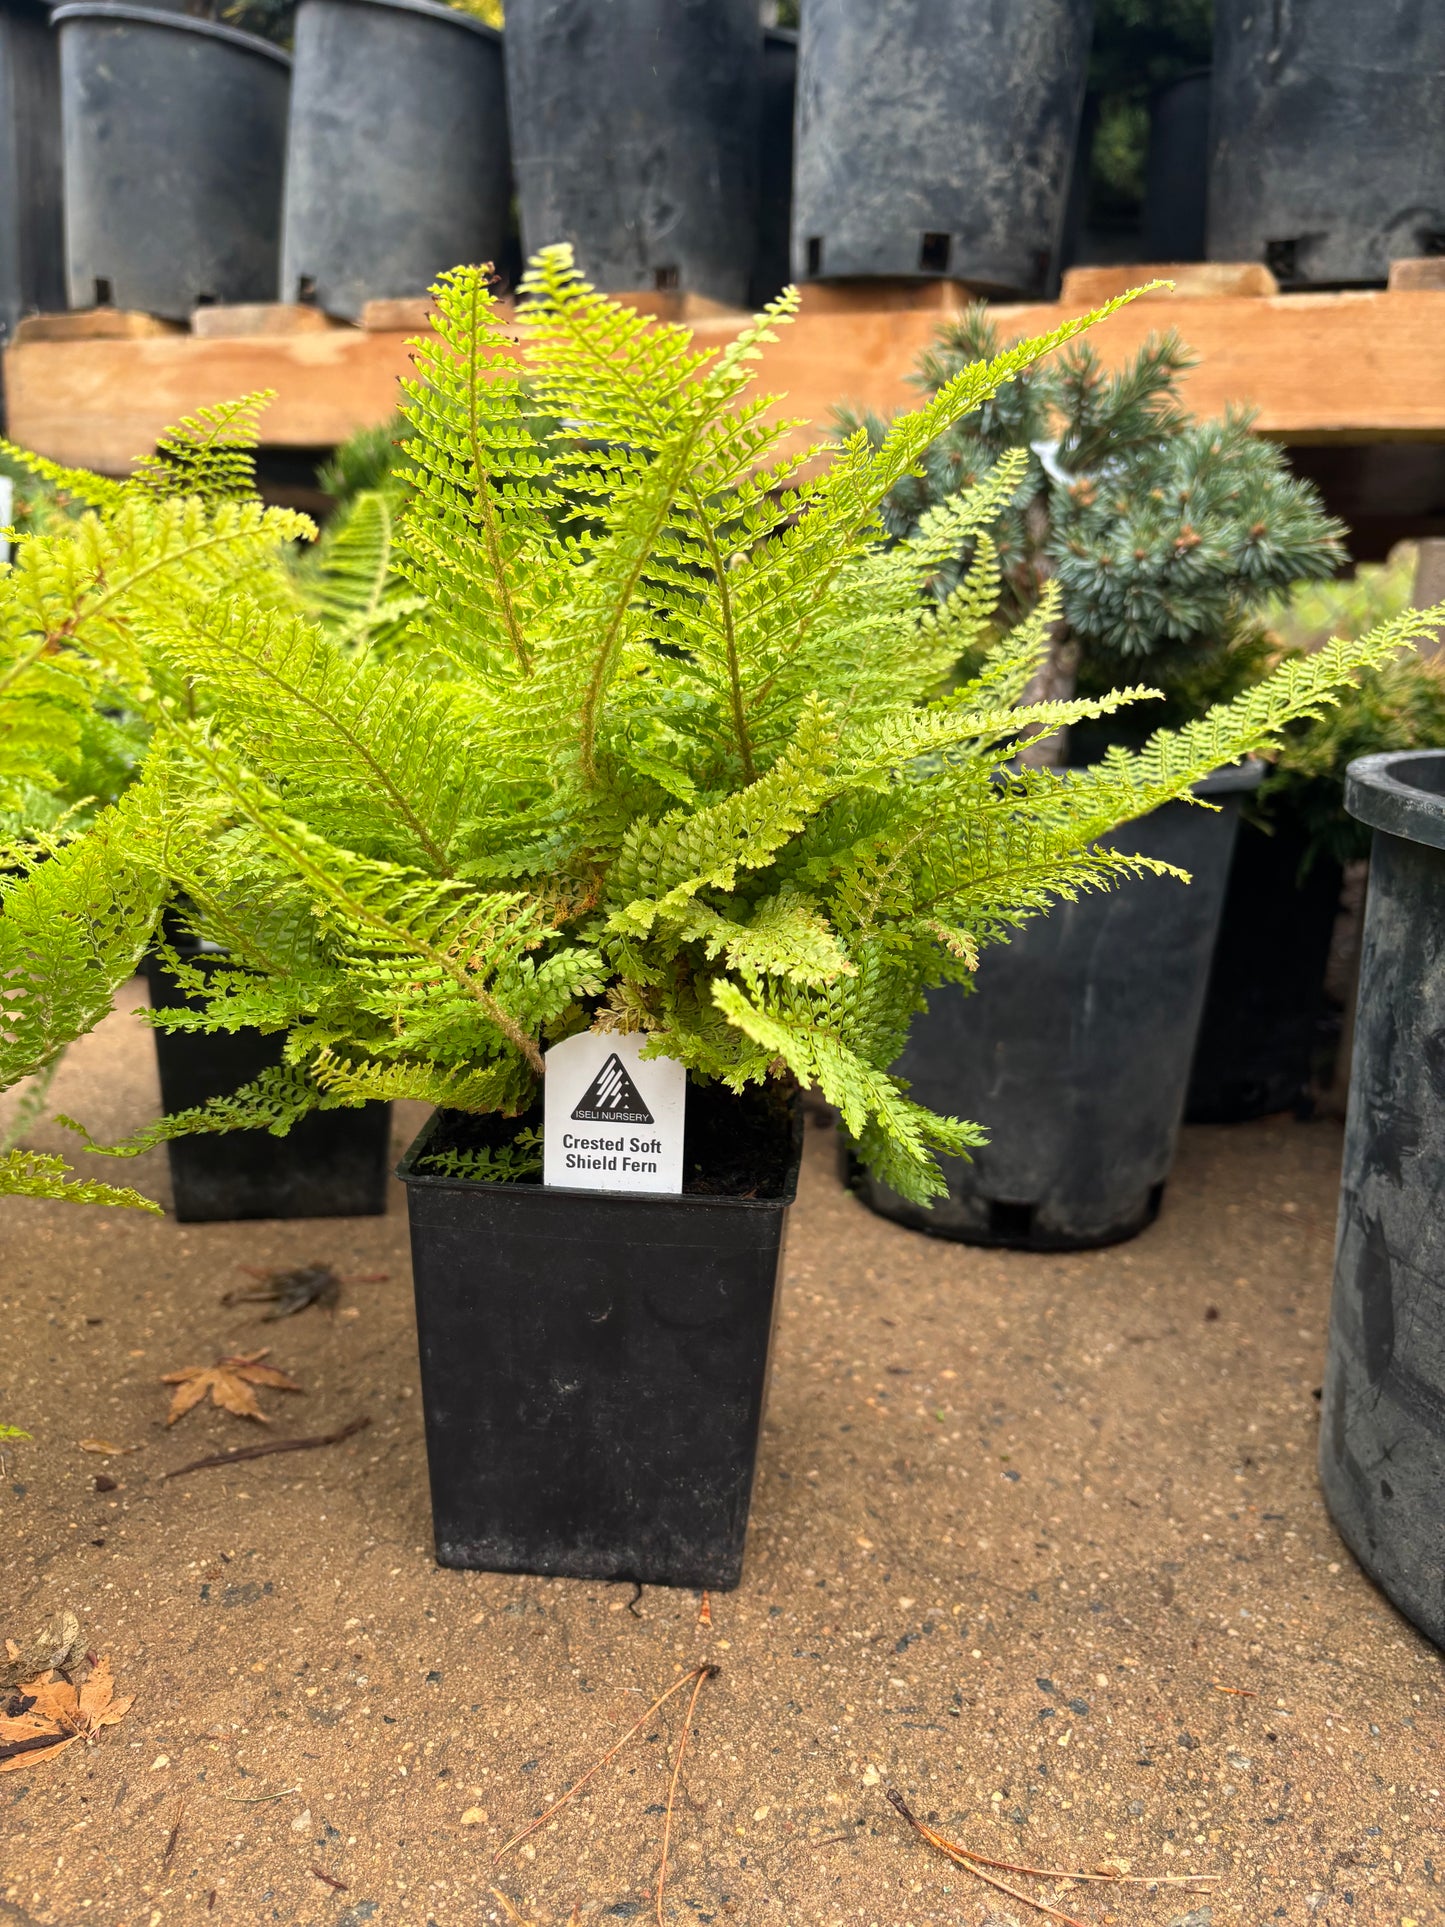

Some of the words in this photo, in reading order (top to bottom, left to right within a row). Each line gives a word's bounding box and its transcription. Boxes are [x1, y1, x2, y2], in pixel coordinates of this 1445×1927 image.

[575, 1110, 599, 1120] ISELI
[601, 1111, 650, 1122] NURSERY
[563, 1134, 624, 1151] Crested
[630, 1137, 662, 1153] Soft
[565, 1154, 617, 1171] Shield
[622, 1157, 657, 1173] Fern
